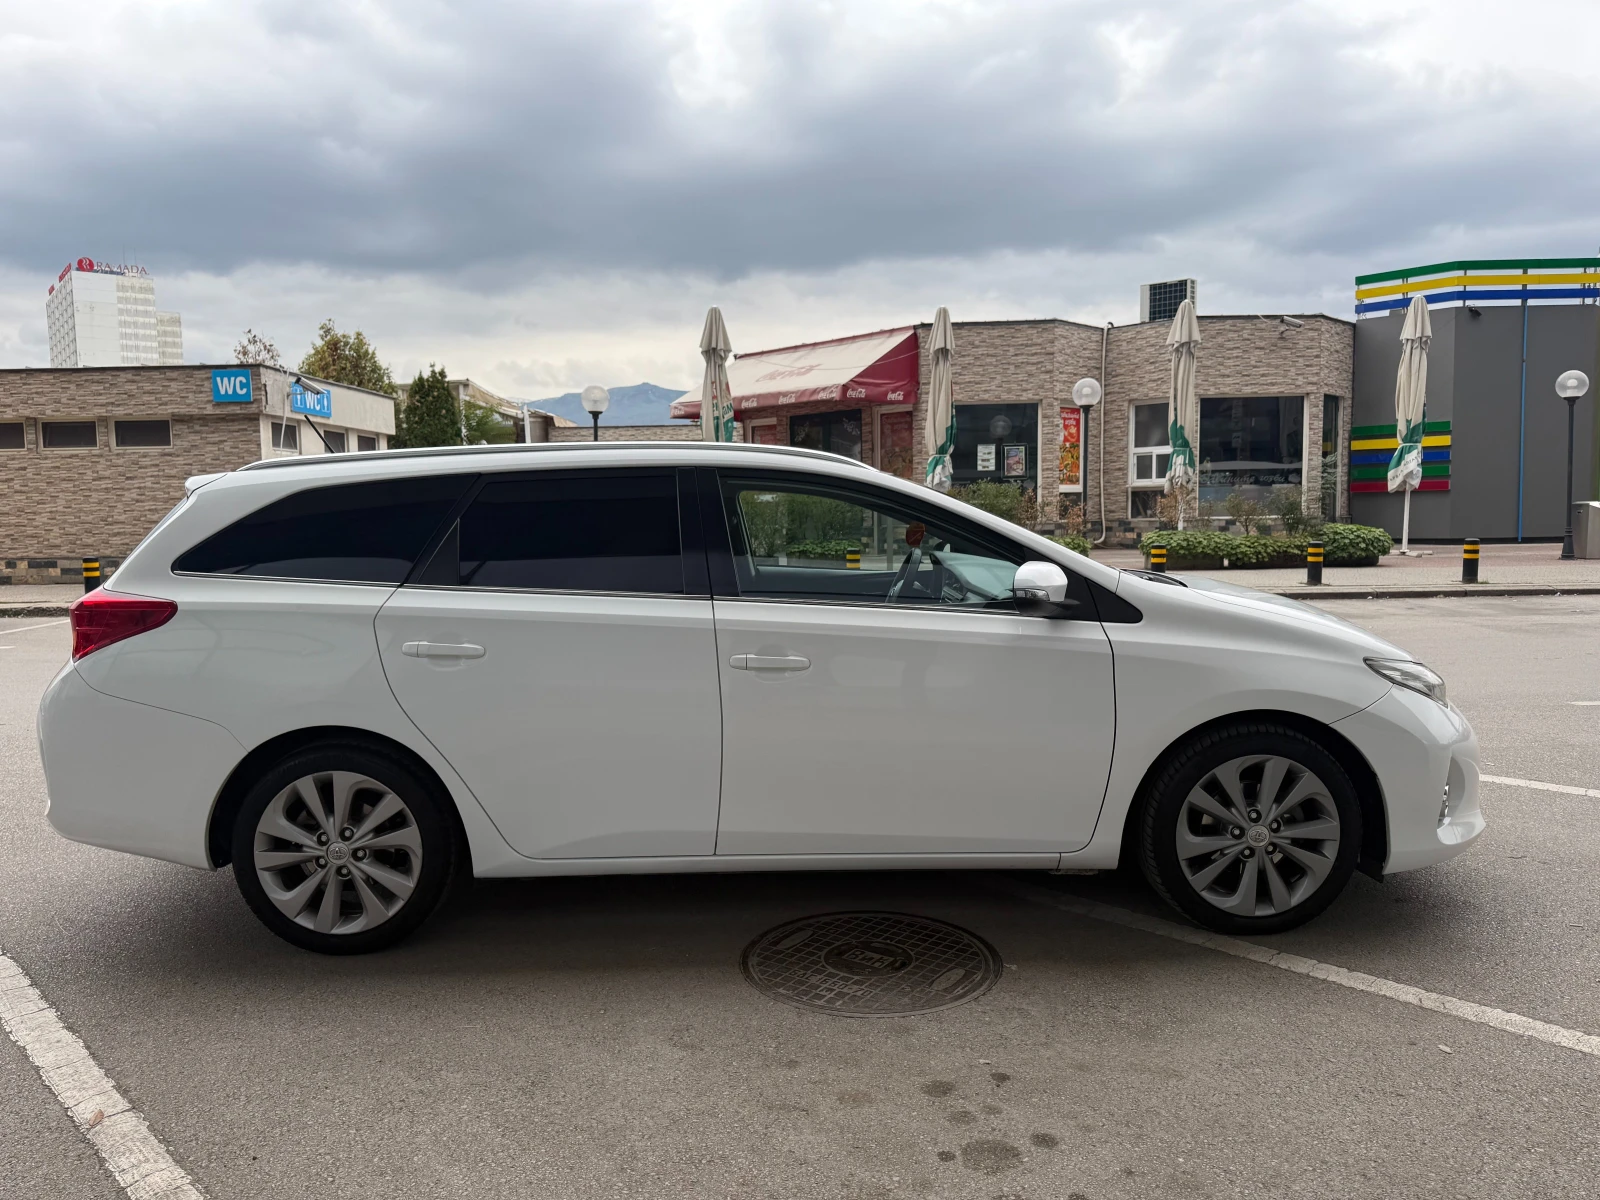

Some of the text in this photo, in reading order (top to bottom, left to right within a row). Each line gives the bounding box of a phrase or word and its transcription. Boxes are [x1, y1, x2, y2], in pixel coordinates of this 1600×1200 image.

[216, 376, 247, 395] WC
[847, 388, 866, 398] Coca-Cola
[887, 391, 904, 401] Coca-Cola
[305, 390, 321, 411] WC
